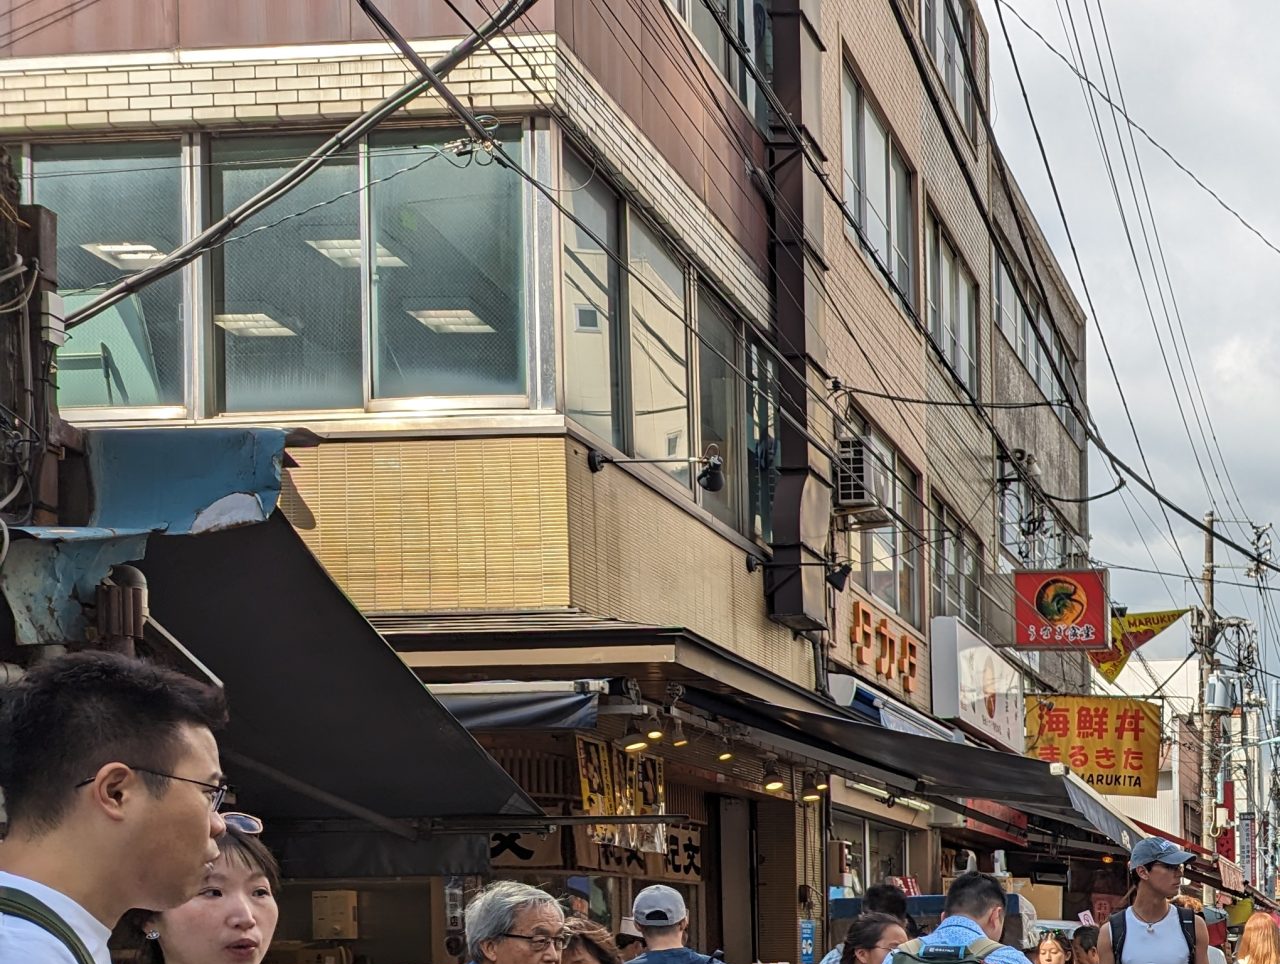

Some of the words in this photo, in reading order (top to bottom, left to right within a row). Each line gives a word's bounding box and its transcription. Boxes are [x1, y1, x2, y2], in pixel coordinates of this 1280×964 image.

[1038, 706, 1145, 741] 海鮮丼
[1038, 744, 1144, 771] まるきた
